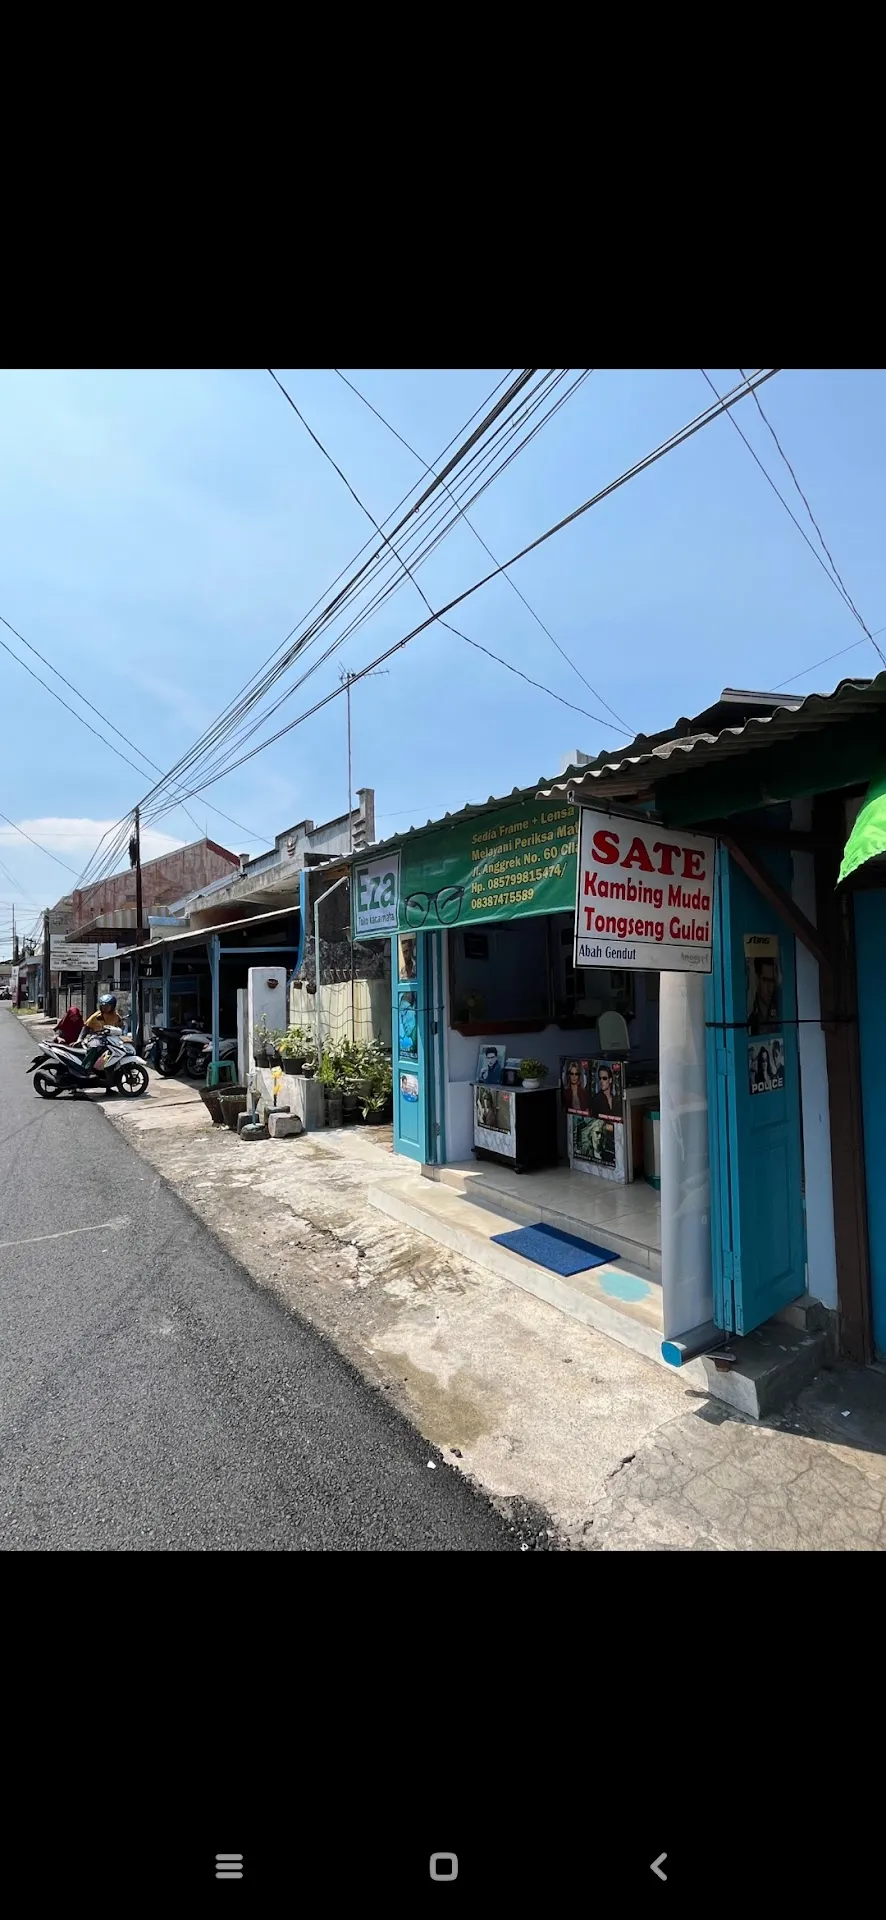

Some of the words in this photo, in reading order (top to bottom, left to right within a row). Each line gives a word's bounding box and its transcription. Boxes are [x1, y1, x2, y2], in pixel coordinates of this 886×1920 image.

[472, 831, 497, 844] Sedia
[499, 820, 529, 836] Frame
[532, 816, 538, 825] +
[540, 806, 575, 824] Lensa
[472, 840, 512, 861] Melayani
[514, 831, 554, 850] Periksa
[482, 856, 521, 874] Anggrek
[523, 852, 541, 865] No.
[543, 846, 558, 860] 60
[591, 830, 707, 881] SATE
[357, 868, 395, 912] Eza
[471, 882, 486, 894] Hp.
[487, 862, 567, 890] 085799815474/
[583, 870, 663, 909] Kambing
[667, 883, 710, 912] Muda
[471, 887, 534, 910] 08387475589
[584, 906, 665, 942] Tongseng
[669, 916, 709, 942] Gulai
[578, 943, 602, 959] Abah
[605, 945, 637, 960] Gendut
[751, 1077, 784, 1094] POLICE
